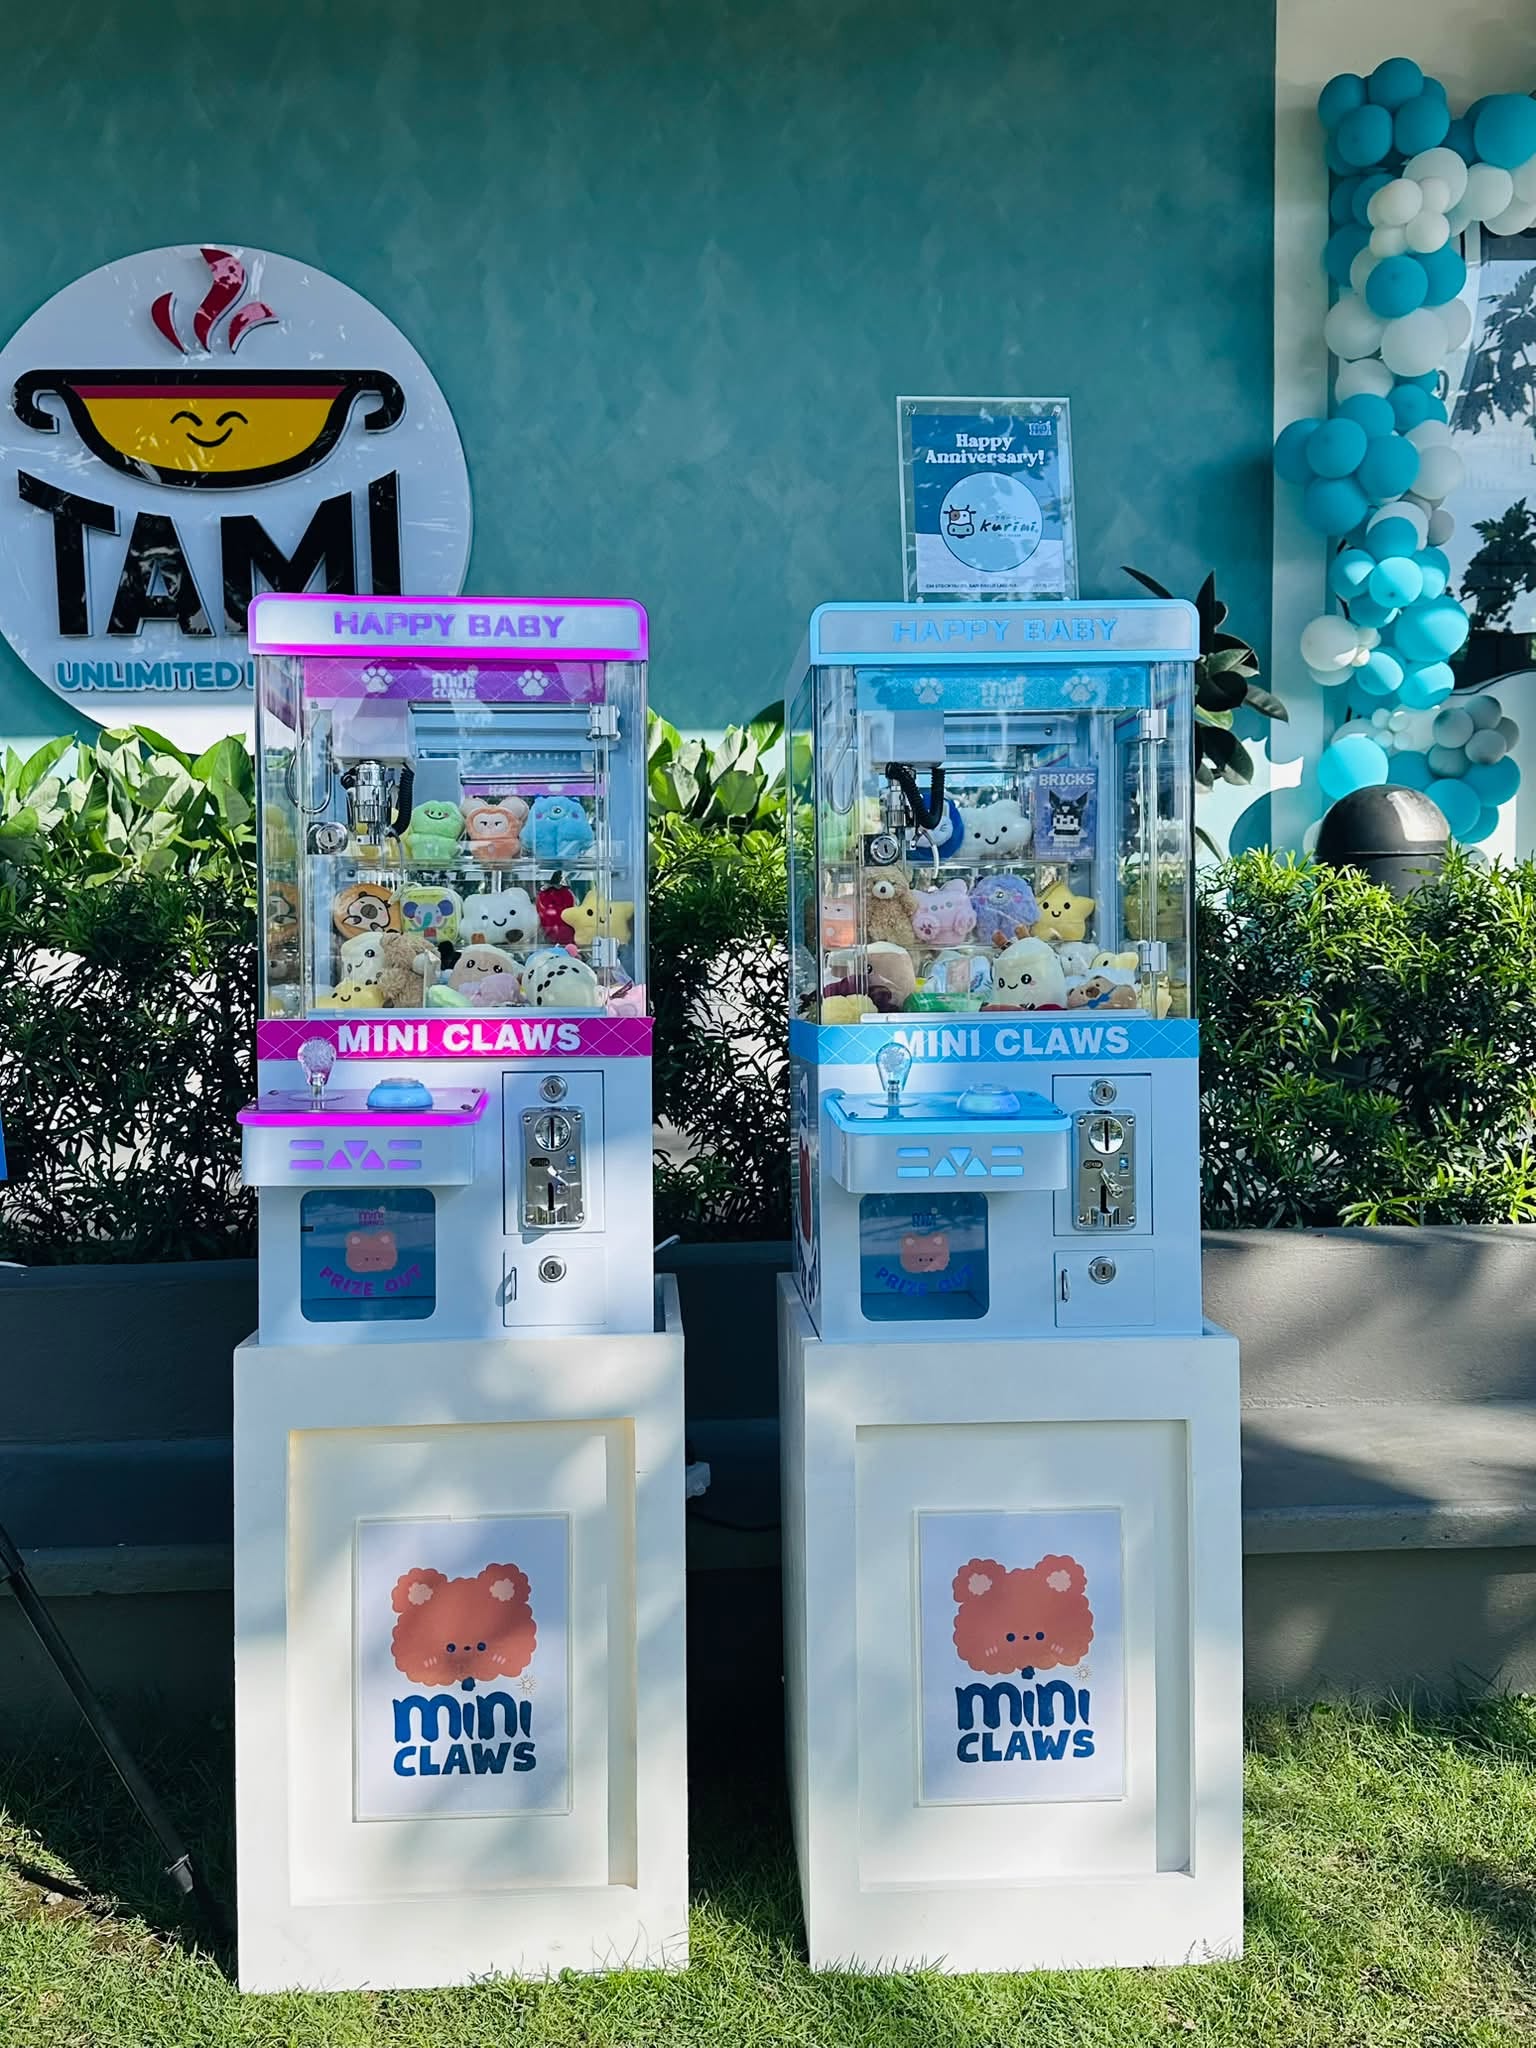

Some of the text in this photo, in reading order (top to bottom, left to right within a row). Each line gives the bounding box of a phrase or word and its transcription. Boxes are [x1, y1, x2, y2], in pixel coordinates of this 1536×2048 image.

[956, 433, 1014, 451] Happy
[925, 449, 1045, 468] Anniversary!
[17, 468, 403, 637] TAMI
[334, 611, 565, 639] HAPPY BABY
[892, 616, 1119, 643] HAPPY BABY
[56, 661, 240, 690] UNLIMITED
[1039, 773, 1097, 787] BRICKS
[338, 1022, 581, 1053] MINI CLAWS
[893, 1026, 1130, 1058] MINI CLAWS
[319, 1263, 422, 1297] PRIZE OUT
[875, 1266, 928, 1297] PRIZE
[392, 1676, 533, 1744] mini
[955, 1666, 1091, 1731] mini
[393, 1742, 537, 1777] CLAWS
[957, 1730, 1096, 1763] CLAWS
